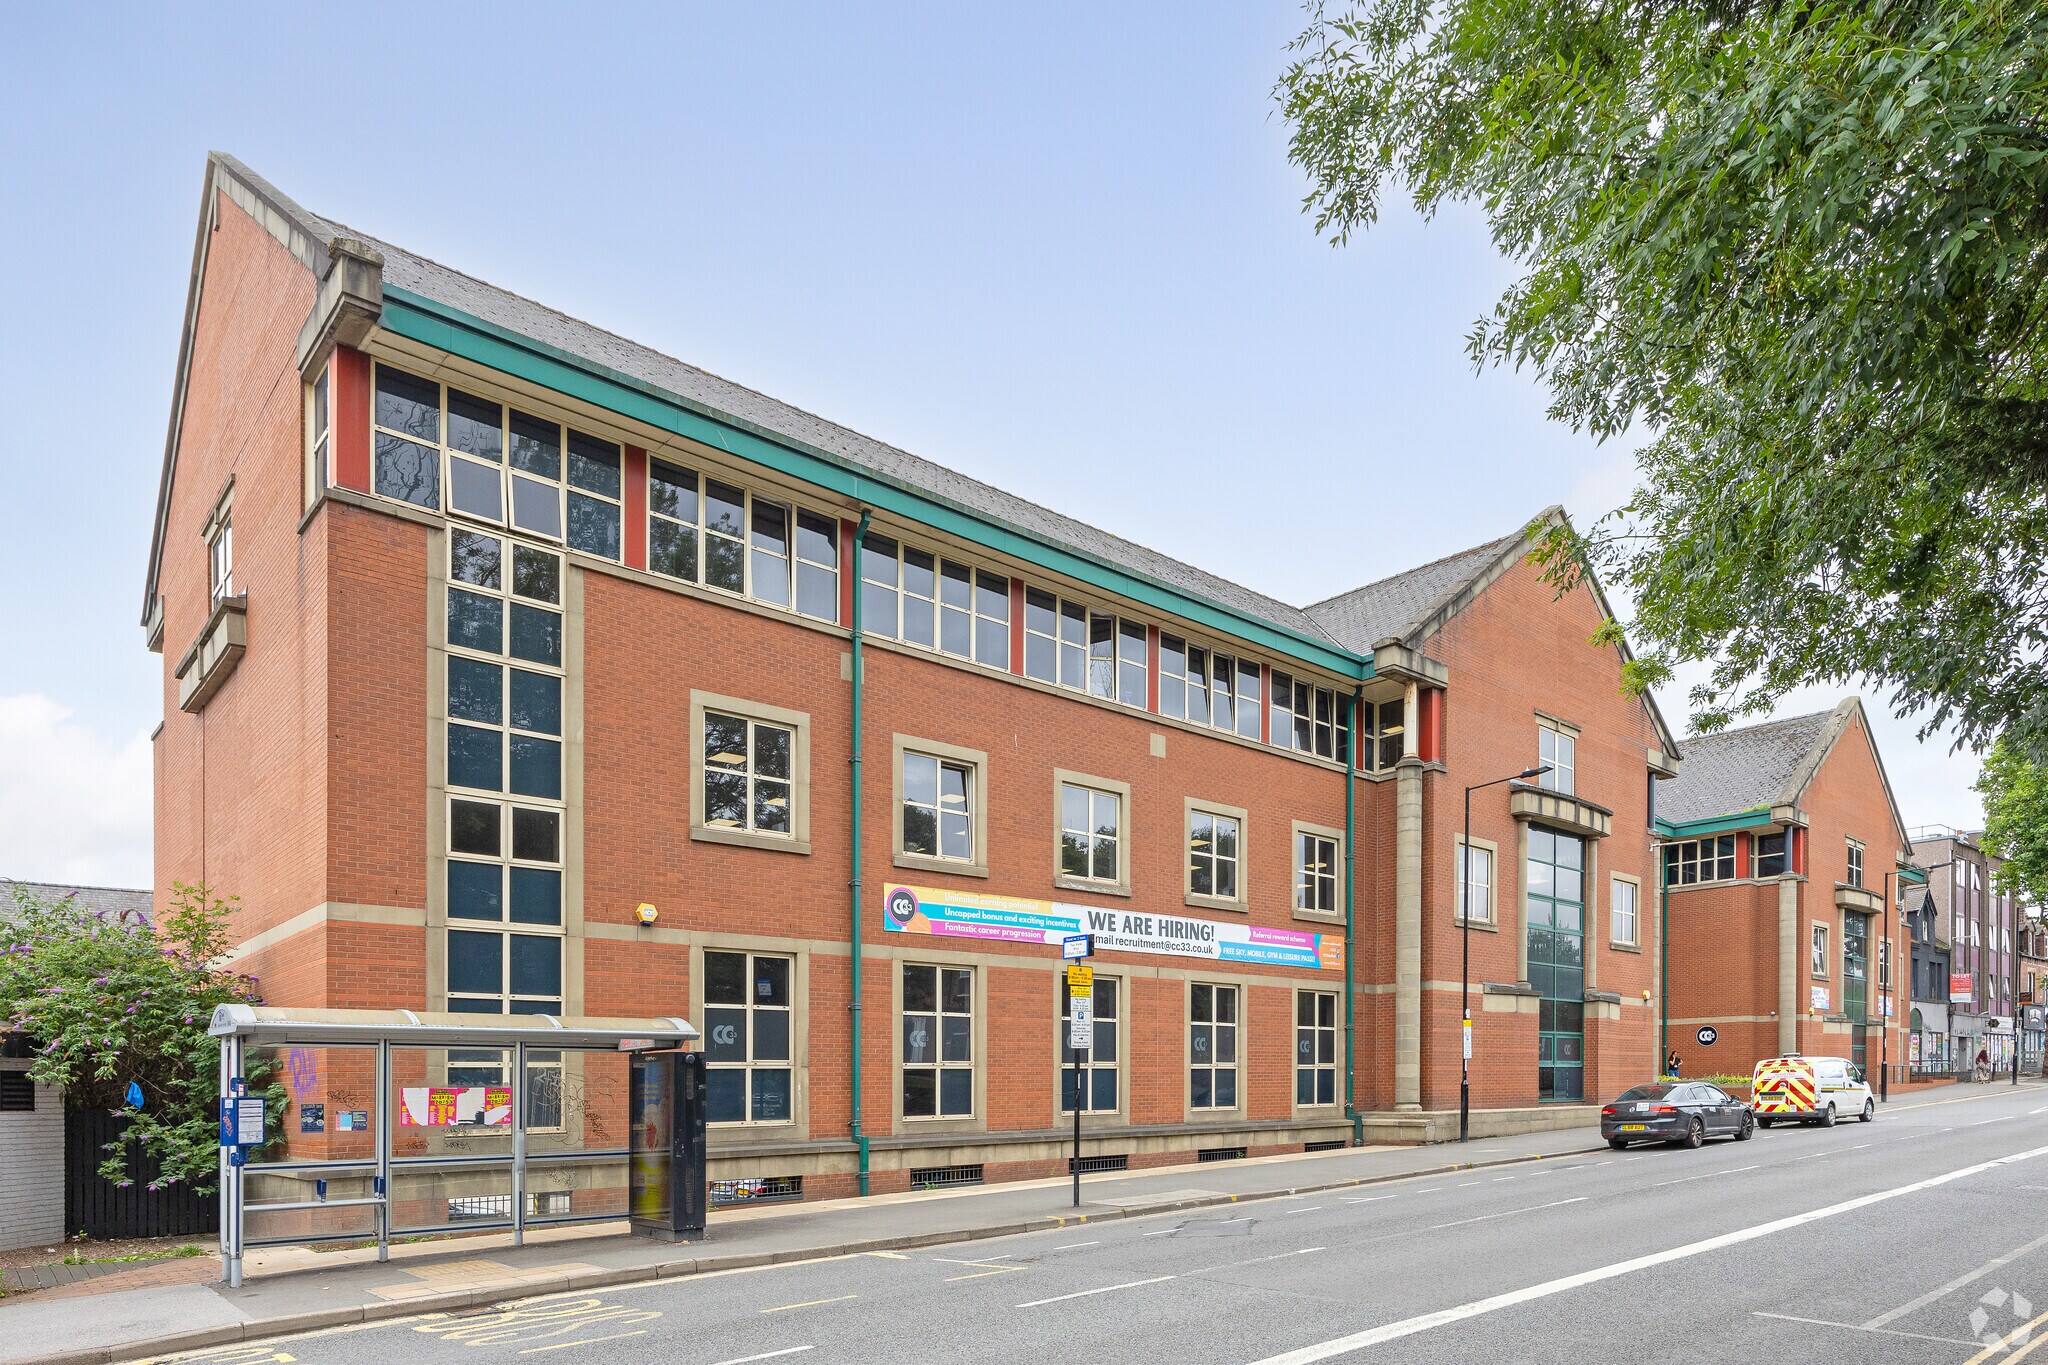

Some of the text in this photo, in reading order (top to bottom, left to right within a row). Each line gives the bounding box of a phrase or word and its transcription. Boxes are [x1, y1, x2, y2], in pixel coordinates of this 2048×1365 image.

[944, 892, 1038, 911] Unlimited earning potential
[944, 907, 1077, 929] Uncapped bonus and exciting incentives
[1087, 910, 1215, 942] WE ARE HIRING!
[944, 922, 1042, 940] Fantastic career progression
[1252, 931, 1272, 939] Referral
[1272, 933, 1290, 941] reward
[1093, 935, 1214, 955] mail recruitment@cc33.co.uk
[1223, 947, 1235, 955] FREE
[1247, 949, 1266, 959] MOBILE,
[1267, 951, 1278, 959] GYM
[1283, 953, 1301, 961] LEISURE
[712, 1024, 738, 1045] CC33
